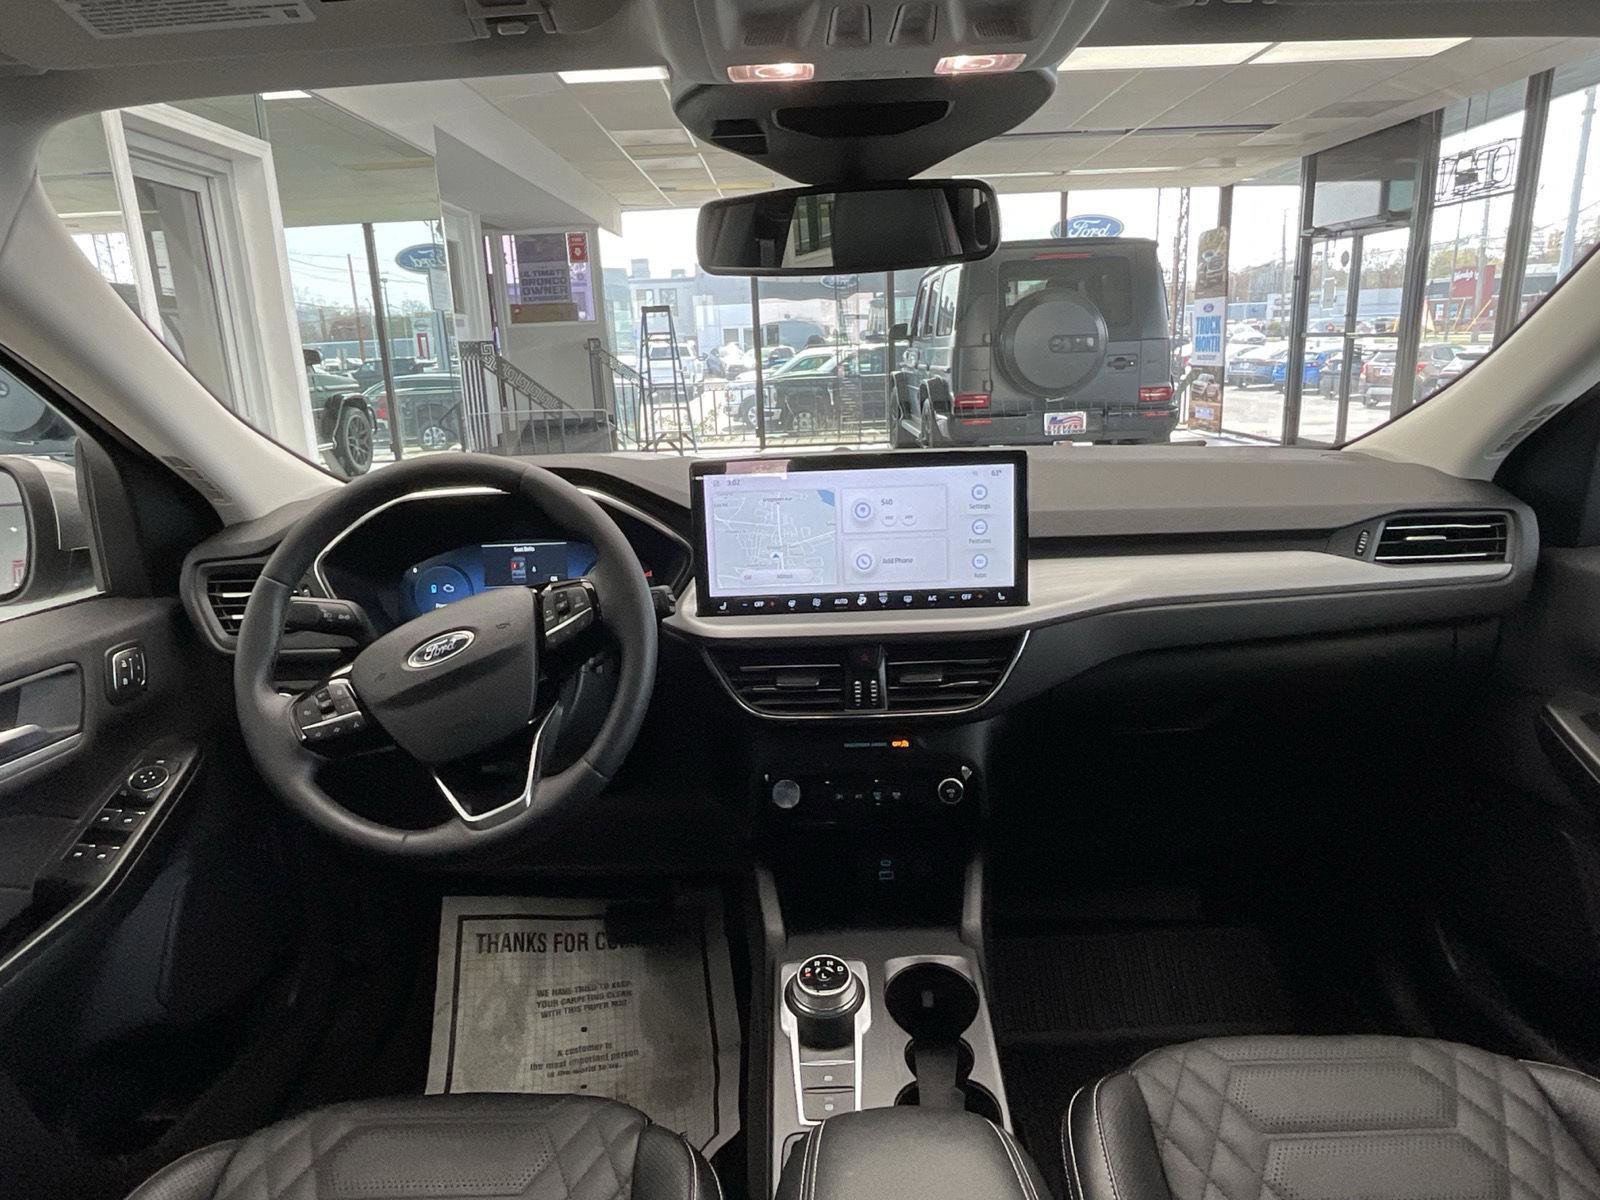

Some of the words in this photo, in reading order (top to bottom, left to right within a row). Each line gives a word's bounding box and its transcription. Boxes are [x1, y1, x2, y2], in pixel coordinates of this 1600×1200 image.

[1068, 220, 1113, 238] Ford
[520, 269, 566, 277] ULTIMATE
[522, 276, 568, 286] BRONCO
[523, 286, 568, 296] OWNER
[1196, 316, 1221, 335] TRUCK
[1195, 335, 1221, 353] MONTH
[424, 637, 457, 662] Ford
[476, 932, 548, 954] THANKS
[553, 931, 589, 953] FOR
[536, 988, 550, 998] WE
[552, 986, 572, 996] HAVE
[574, 984, 598, 994] TRIED
[600, 982, 609, 991] TO
[611, 980, 631, 989] KEEP
[536, 1000, 559, 1009] YOUR
[560, 994, 605, 1006] CARPETING
[606, 990, 632, 1000] CLEAN
[541, 1008, 562, 1019] WITH
[564, 1006, 582, 1015] THIS
[584, 1002, 609, 1012] PAPER
[564, 1043, 603, 1056] customer
[530, 1062, 543, 1071] the
[546, 1060, 567, 1070] most
[568, 1053, 609, 1068] important
[610, 1049, 639, 1062] person
[572, 1066, 596, 1075] world
